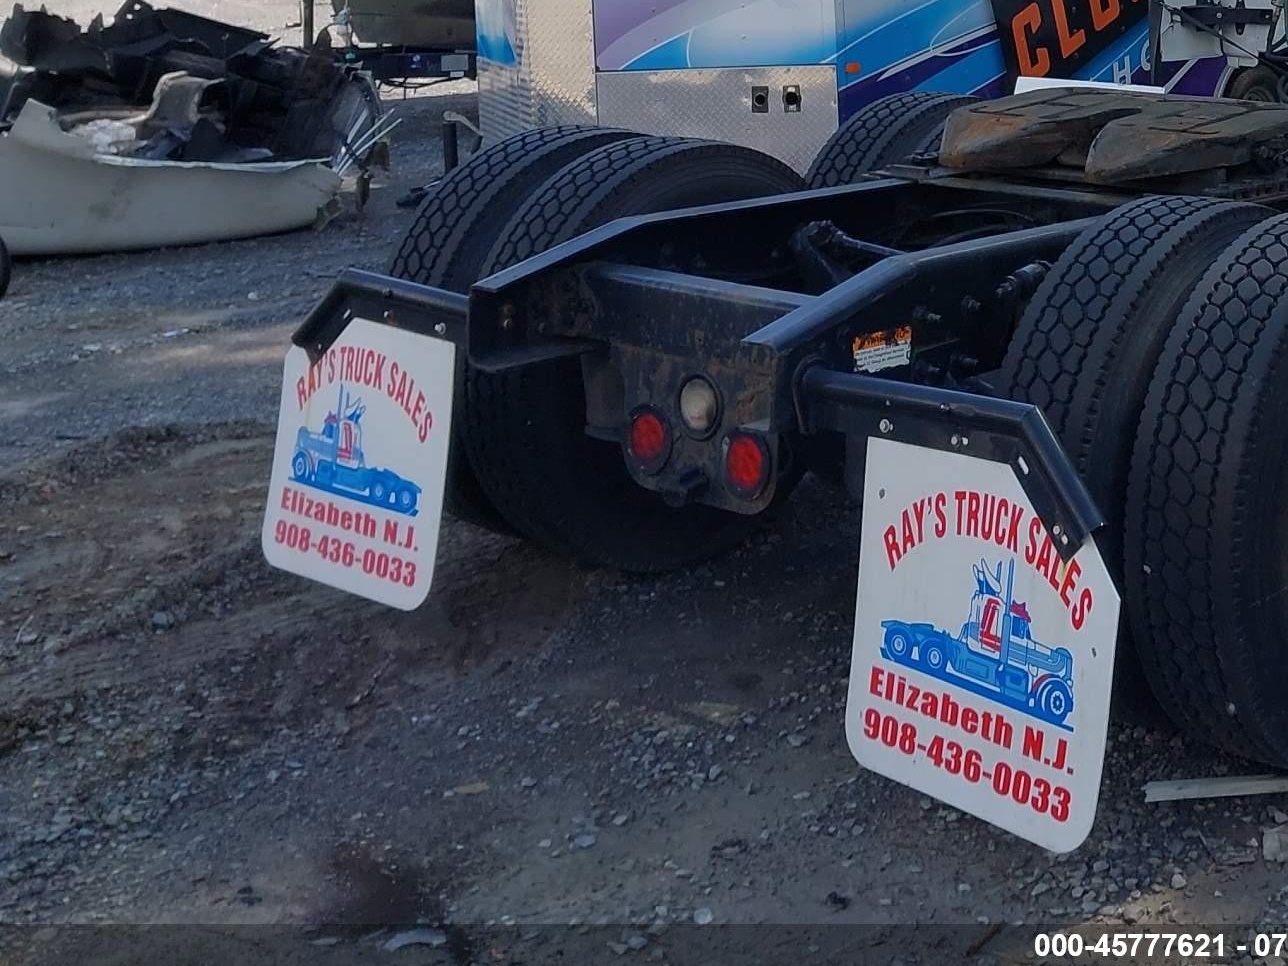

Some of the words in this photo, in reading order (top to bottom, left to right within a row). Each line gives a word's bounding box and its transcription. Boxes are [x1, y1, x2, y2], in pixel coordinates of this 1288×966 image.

[340, 345, 386, 391] TRUCK
[275, 519, 417, 588] 908-436-0033
[281, 487, 376, 539] Elizabeth
[384, 519, 419, 552] N.J.
[884, 492, 947, 572] RAY'S
[954, 490, 1025, 555] TRUCK
[1024, 516, 1093, 631] SALES
[863, 707, 1072, 823] 908-436-0033
[869, 665, 1014, 751] Elizabeth
[1022, 725, 1075, 776] N.J.
